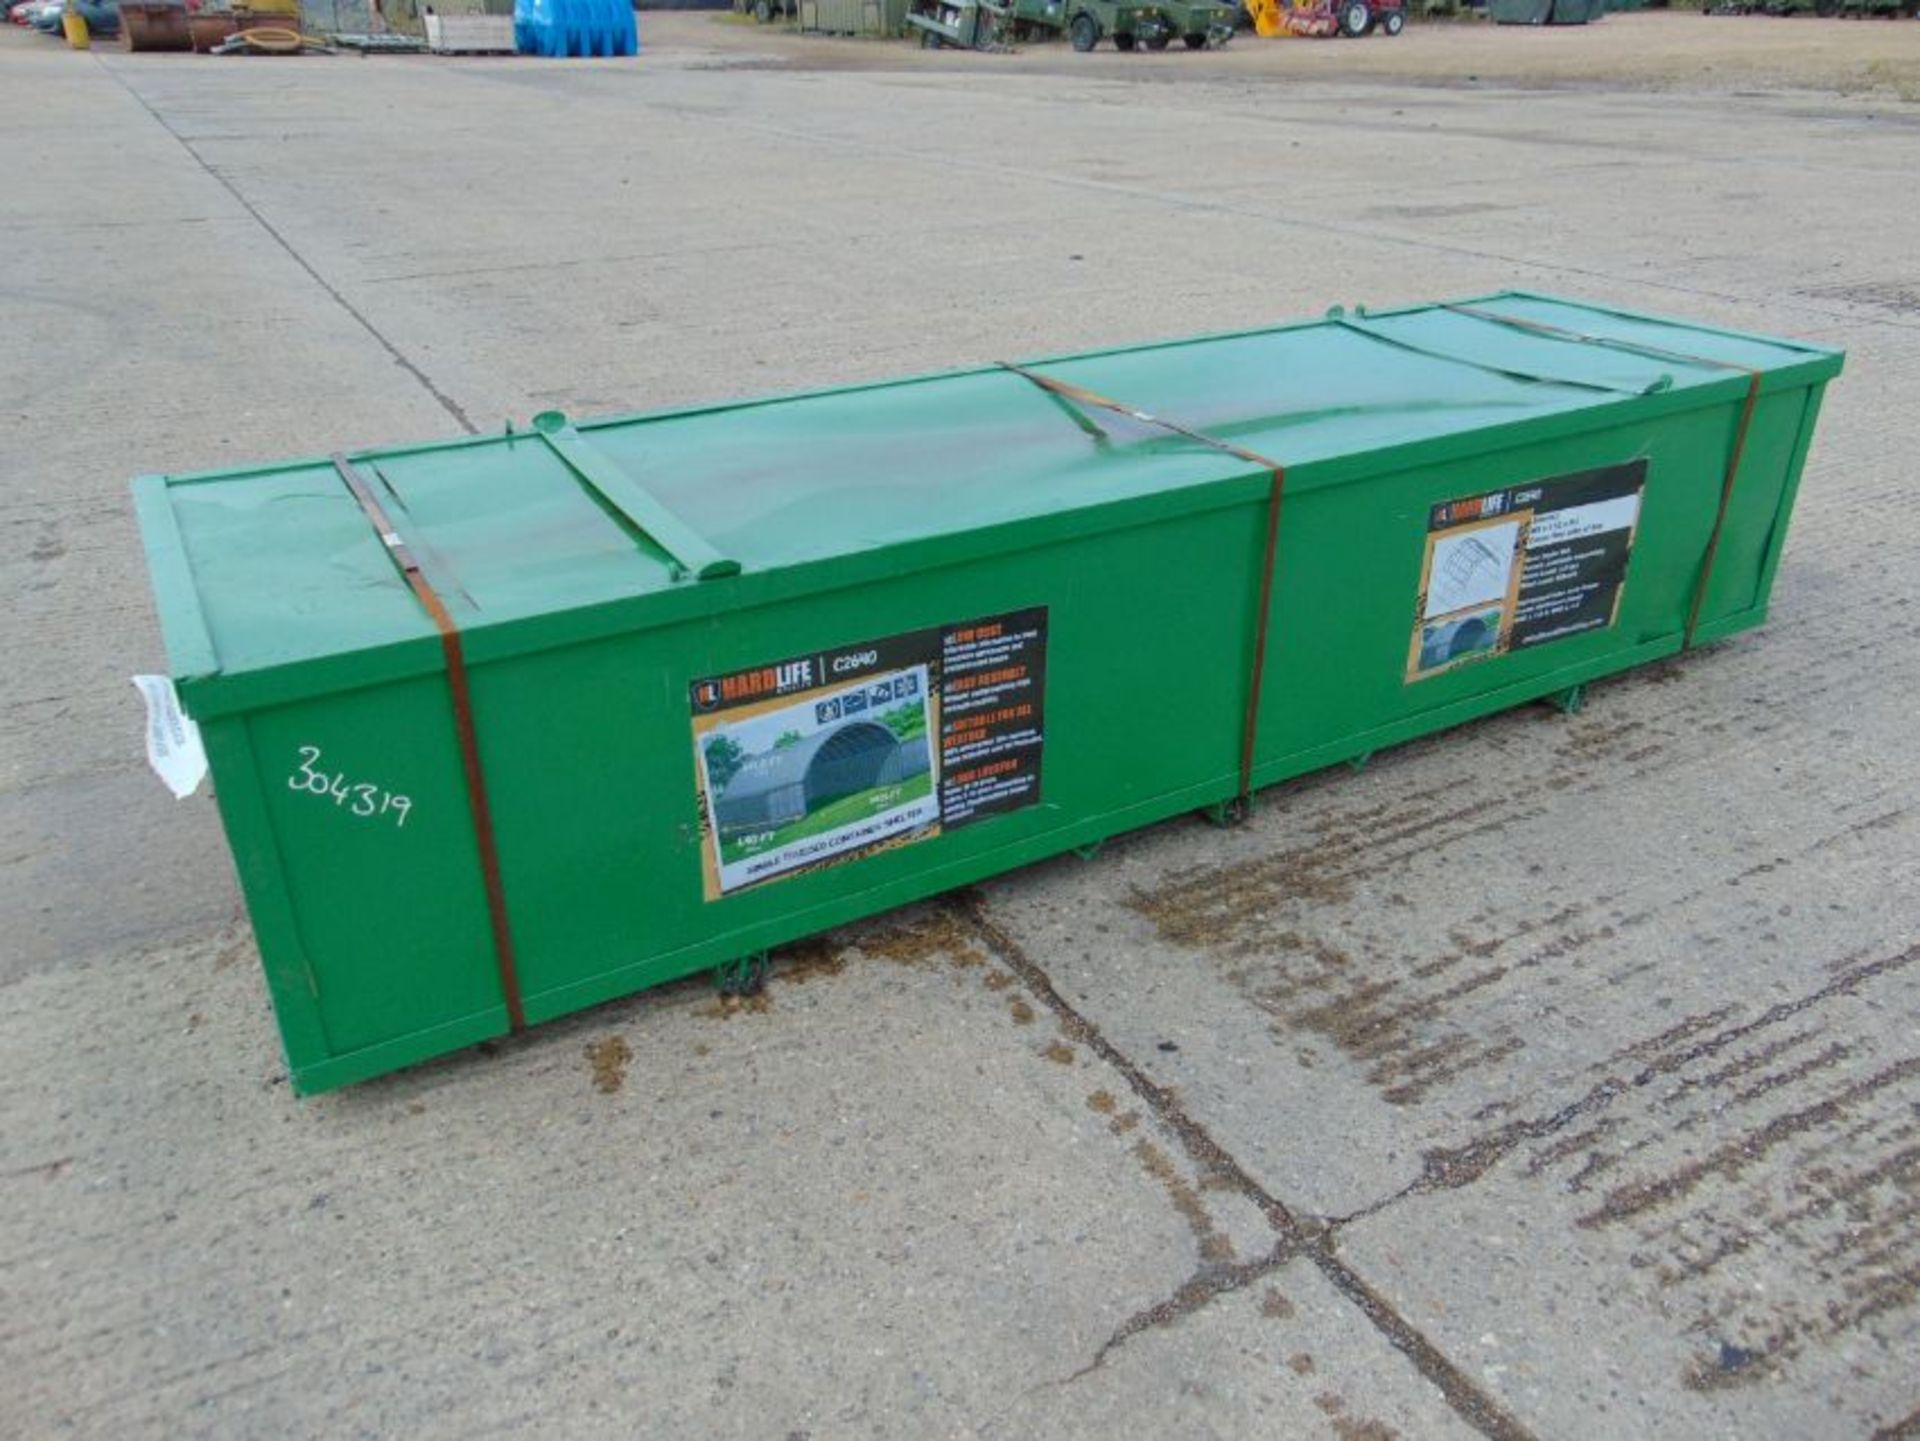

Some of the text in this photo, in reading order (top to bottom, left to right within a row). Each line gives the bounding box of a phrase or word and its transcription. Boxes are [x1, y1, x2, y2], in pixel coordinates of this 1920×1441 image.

[722, 660, 812, 700] HARDLIFE
[833, 650, 878, 673] C2640
[288, 746, 412, 828] 304319
